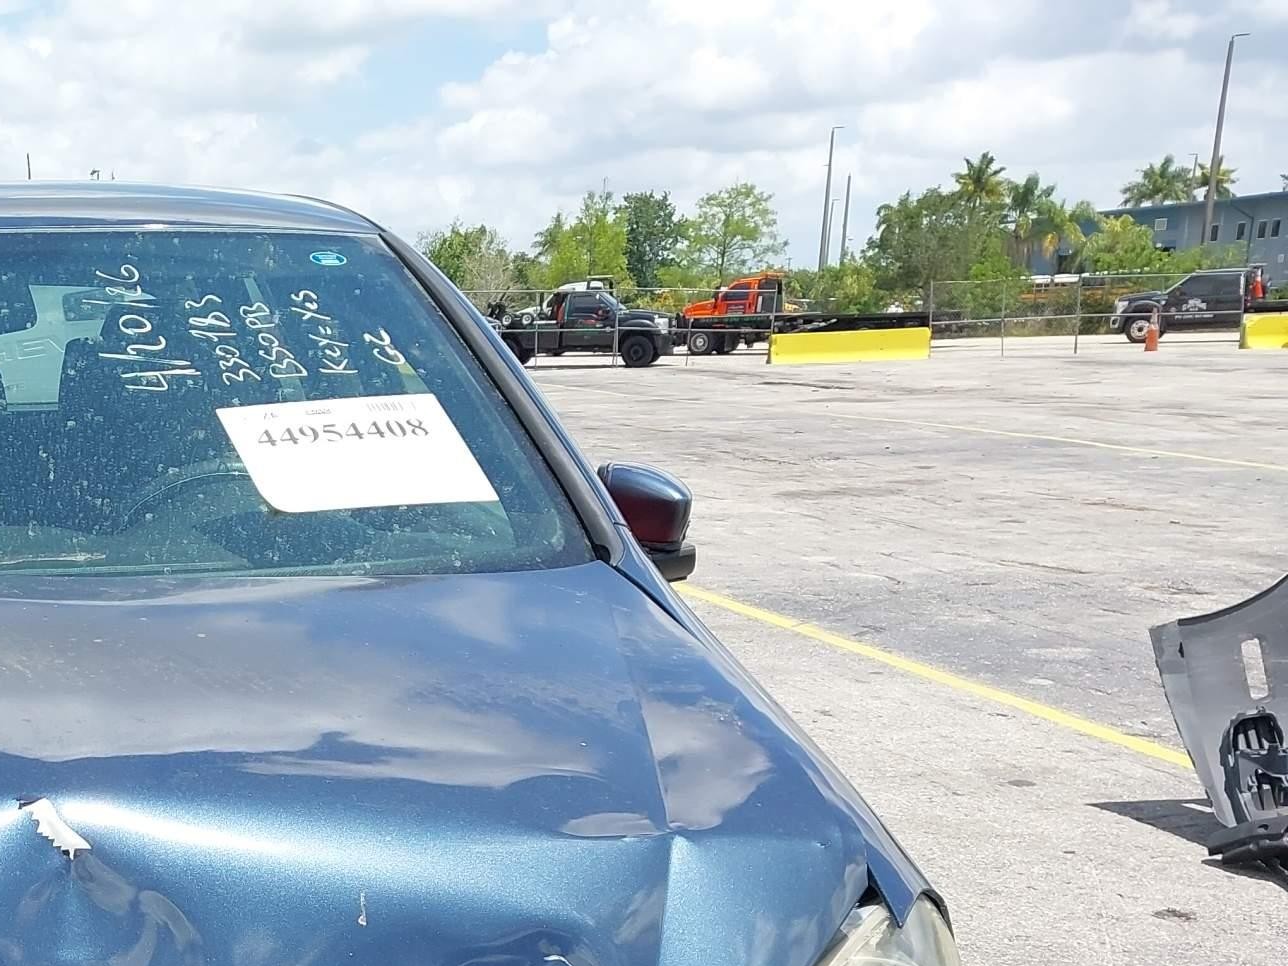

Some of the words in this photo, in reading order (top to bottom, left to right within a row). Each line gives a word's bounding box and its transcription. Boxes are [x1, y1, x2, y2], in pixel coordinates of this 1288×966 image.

[83, 264, 202, 391] 4/20/26
[185, 294, 262, 386] 330183
[258, 418, 430, 446] 44954408
